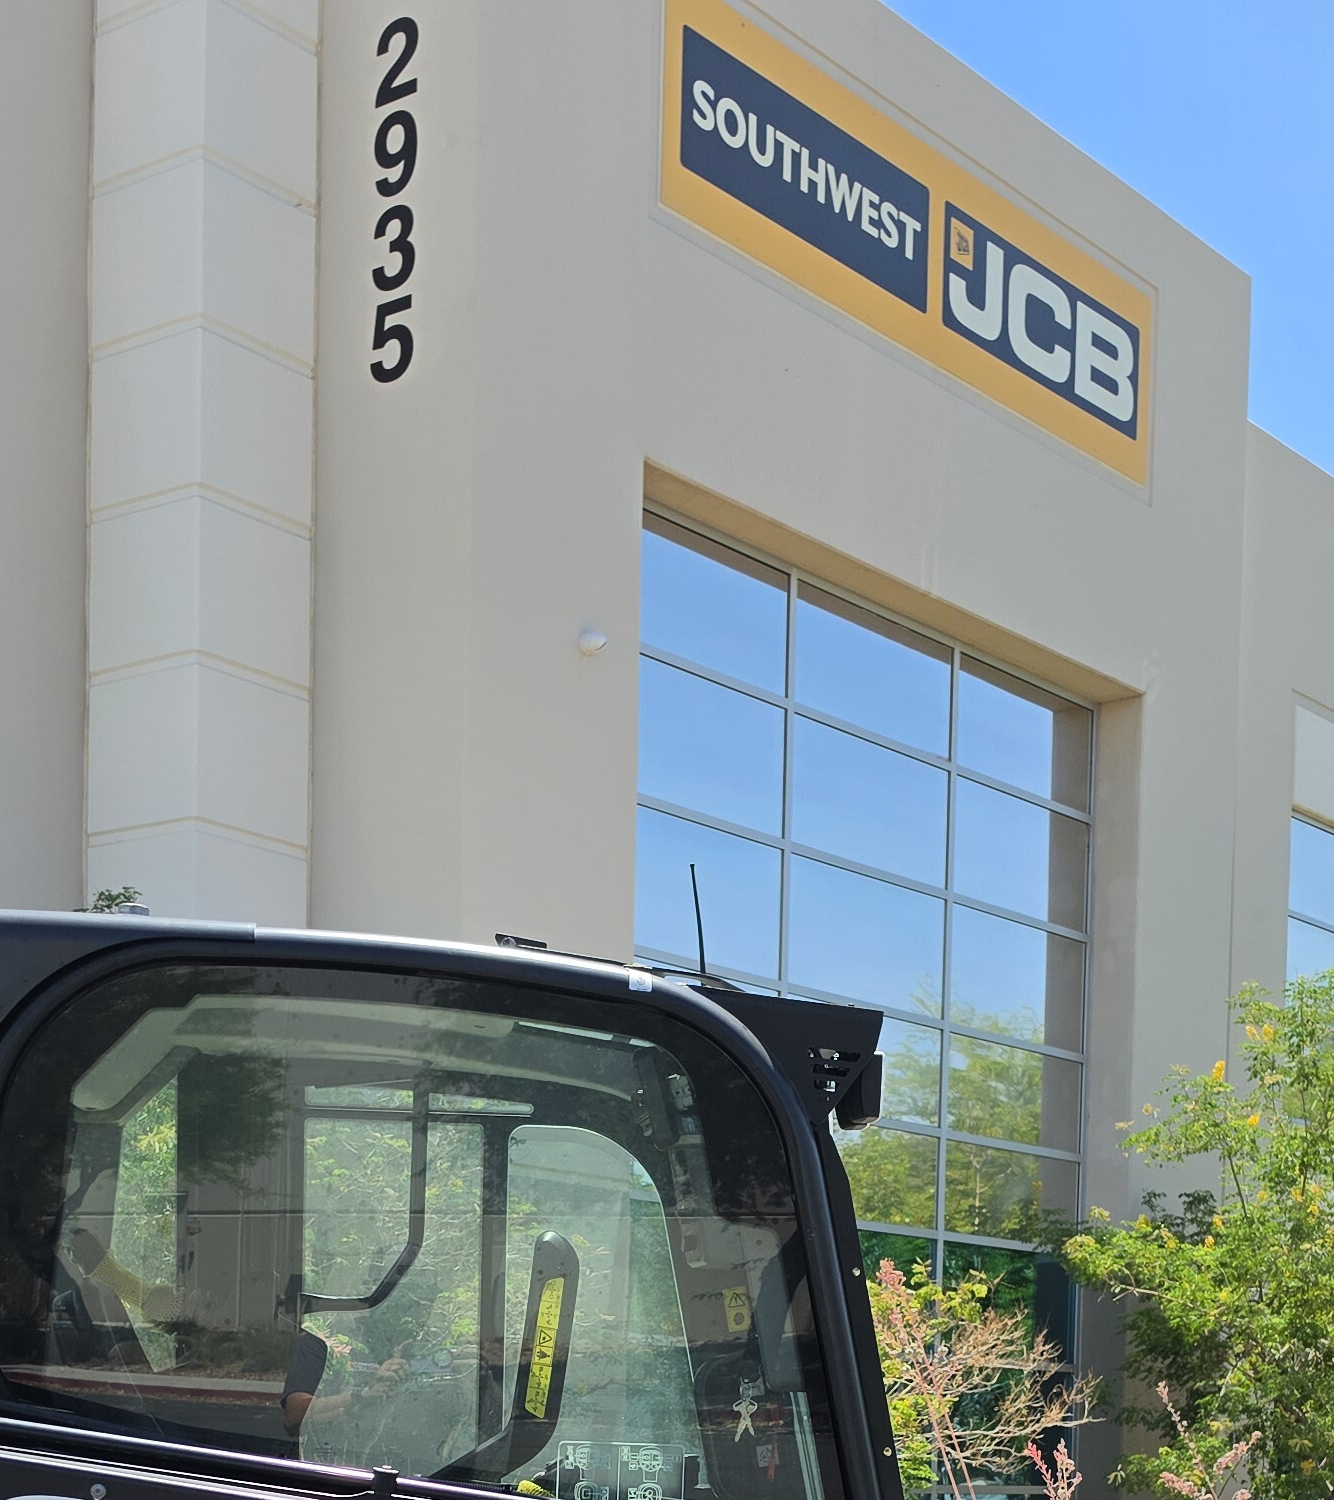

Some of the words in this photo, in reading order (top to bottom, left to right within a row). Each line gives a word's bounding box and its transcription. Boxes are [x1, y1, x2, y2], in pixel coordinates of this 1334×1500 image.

[370, 16, 419, 384] 2935
[692, 79, 922, 260] SOUTHWEST
[948, 240, 1135, 422] JCB
